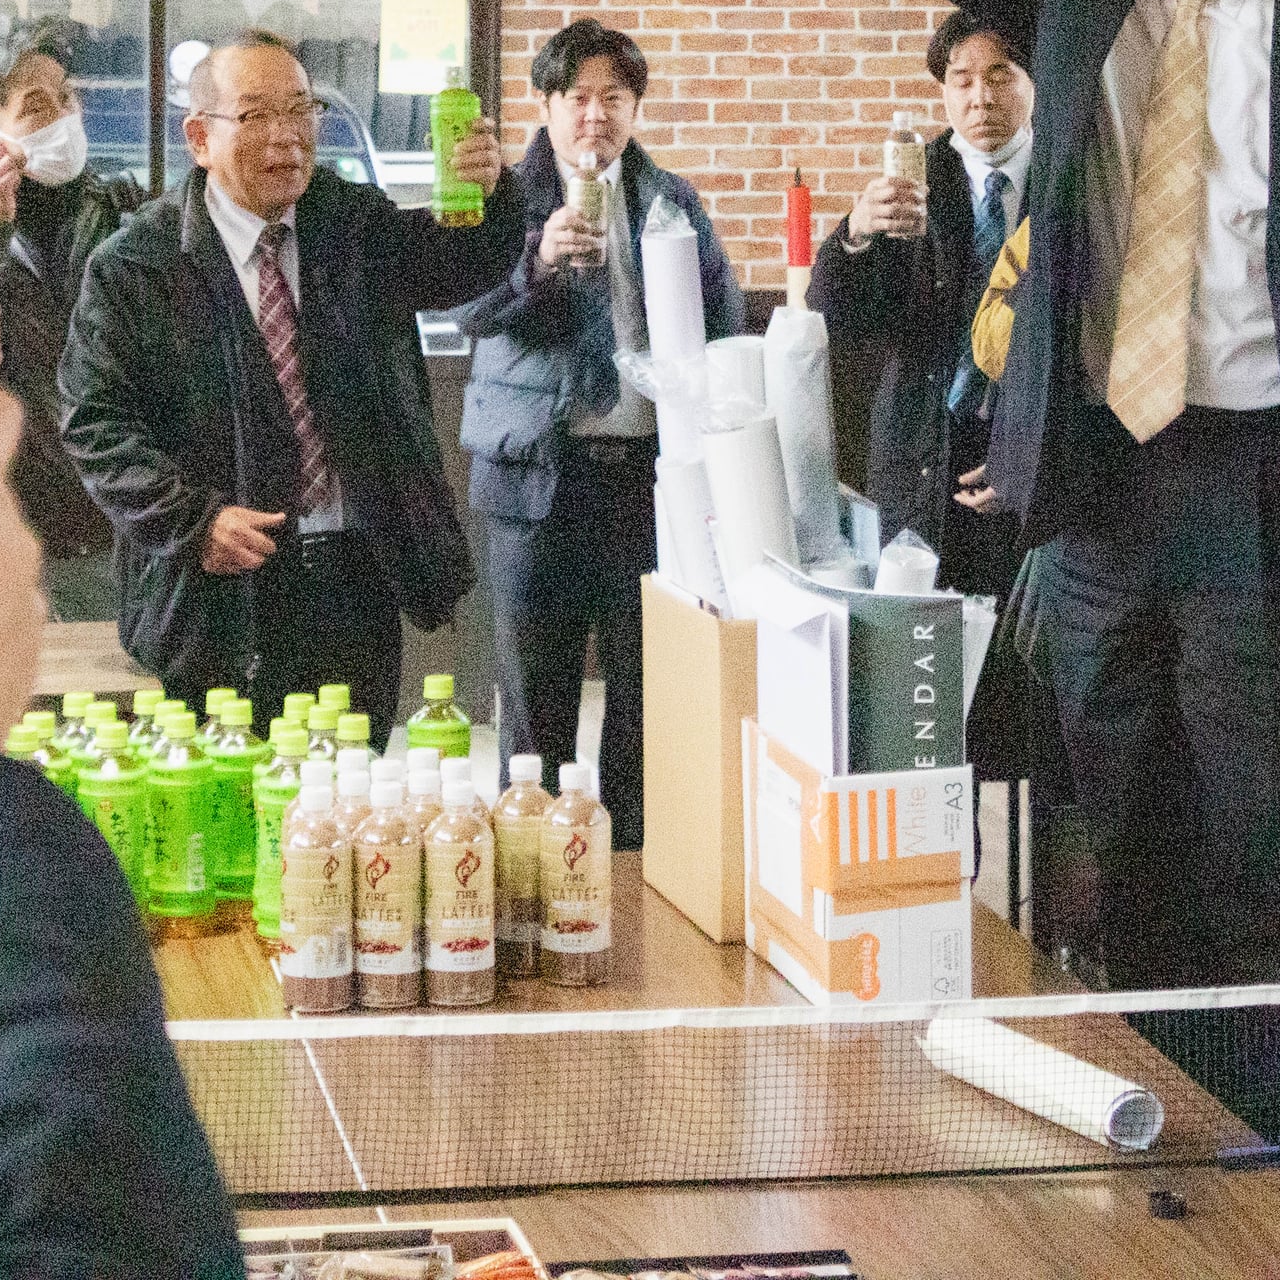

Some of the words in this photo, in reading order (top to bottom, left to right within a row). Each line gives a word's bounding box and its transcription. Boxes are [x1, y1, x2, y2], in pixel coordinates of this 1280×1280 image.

[944, 781, 964, 811] A3
[901, 786, 927, 854] White
[563, 873, 586, 883] FIRE
[365, 892, 388, 902] FIRE
[456, 889, 478, 900] FIRE
